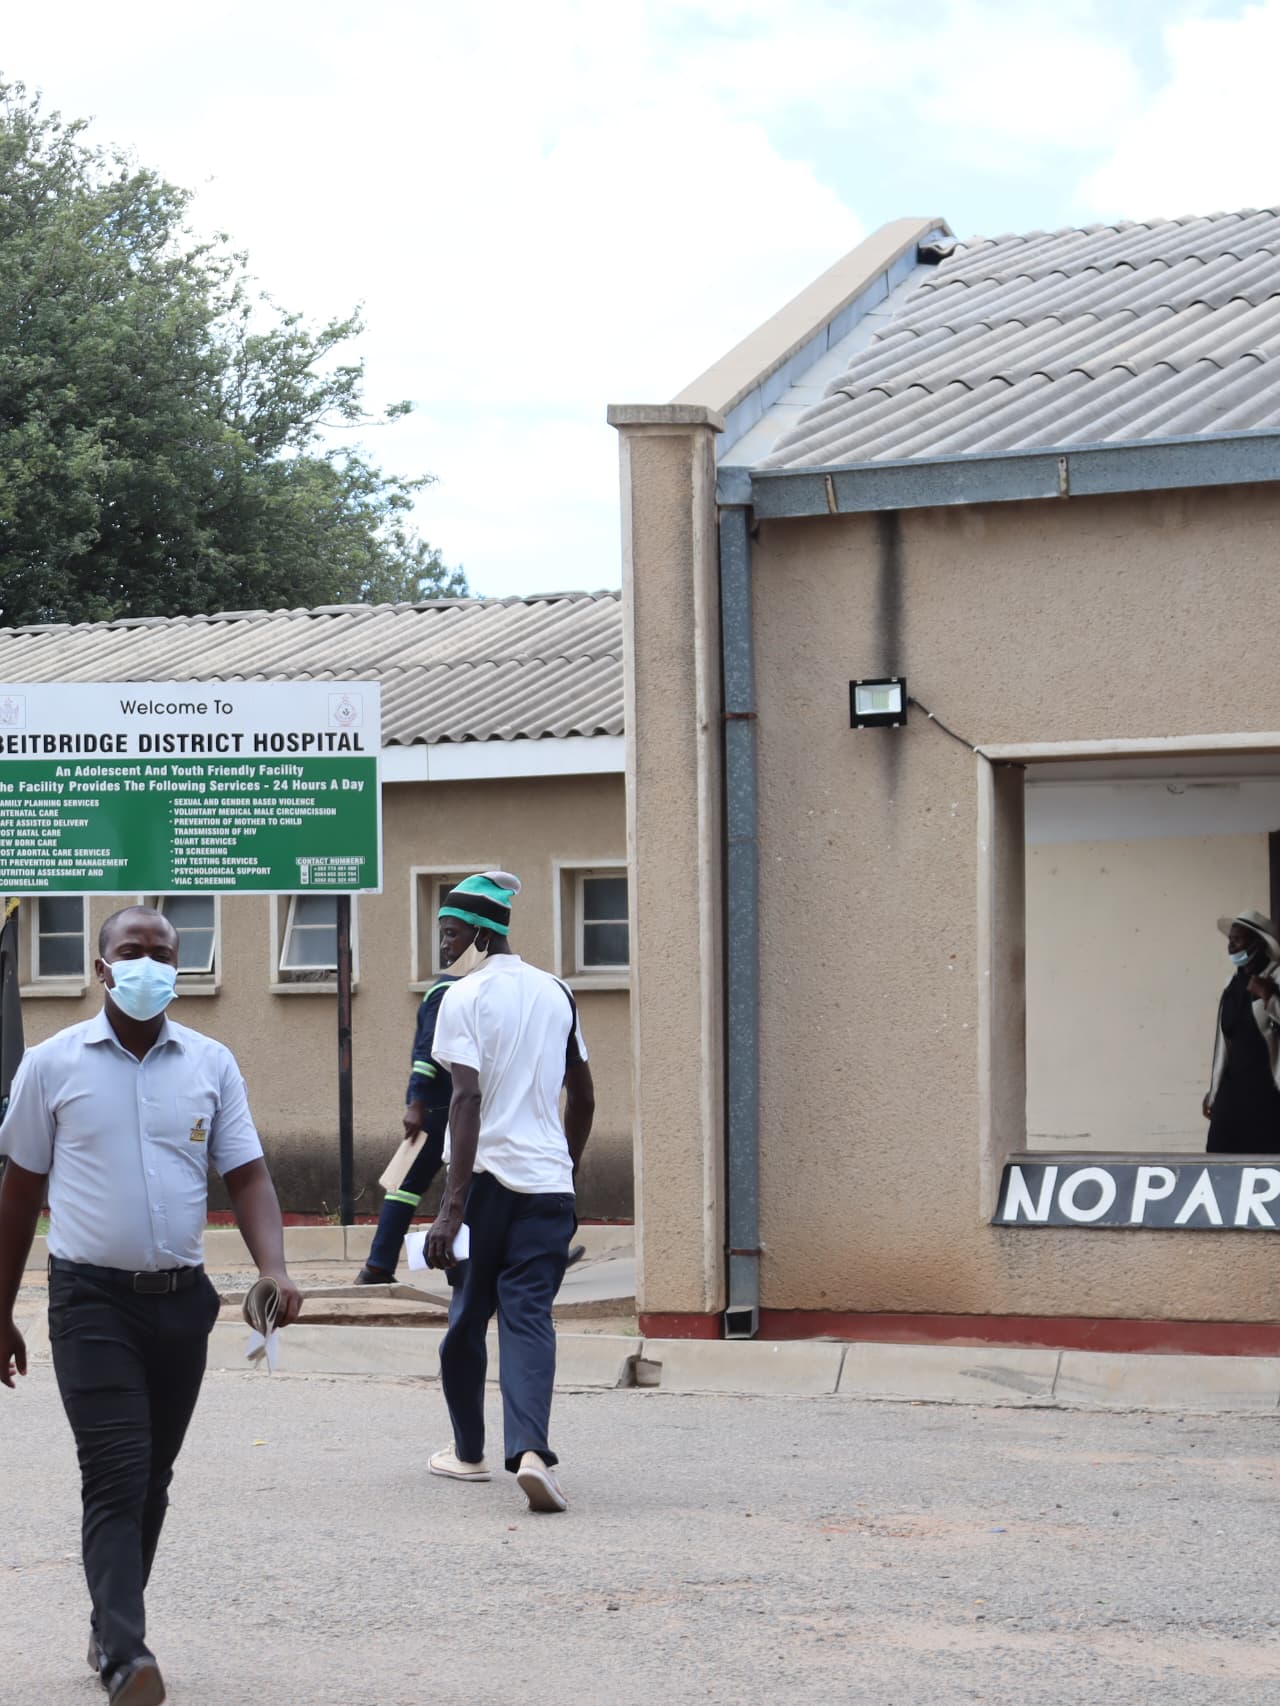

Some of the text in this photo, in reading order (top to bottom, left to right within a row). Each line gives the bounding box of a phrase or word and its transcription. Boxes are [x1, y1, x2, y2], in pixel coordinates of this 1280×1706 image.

[120, 700, 233, 714] Welcome To
[138, 733, 244, 753] DISTRICT
[254, 732, 364, 752] HOSPITAL
[56, 764, 304, 779] An Adolescent And Youth Friendly Facility
[18, 782, 64, 795] Facility
[68, 781, 120, 792] Provides
[124, 781, 146, 792] The
[150, 781, 206, 795] Following
[210, 780, 260, 792] Services
[273, 780, 288, 791] 24
[292, 780, 326, 791] Hours
[330, 780, 340, 790] A
[342, 780, 364, 794] Day
[1003, 1166, 1280, 1226] NO PAR
